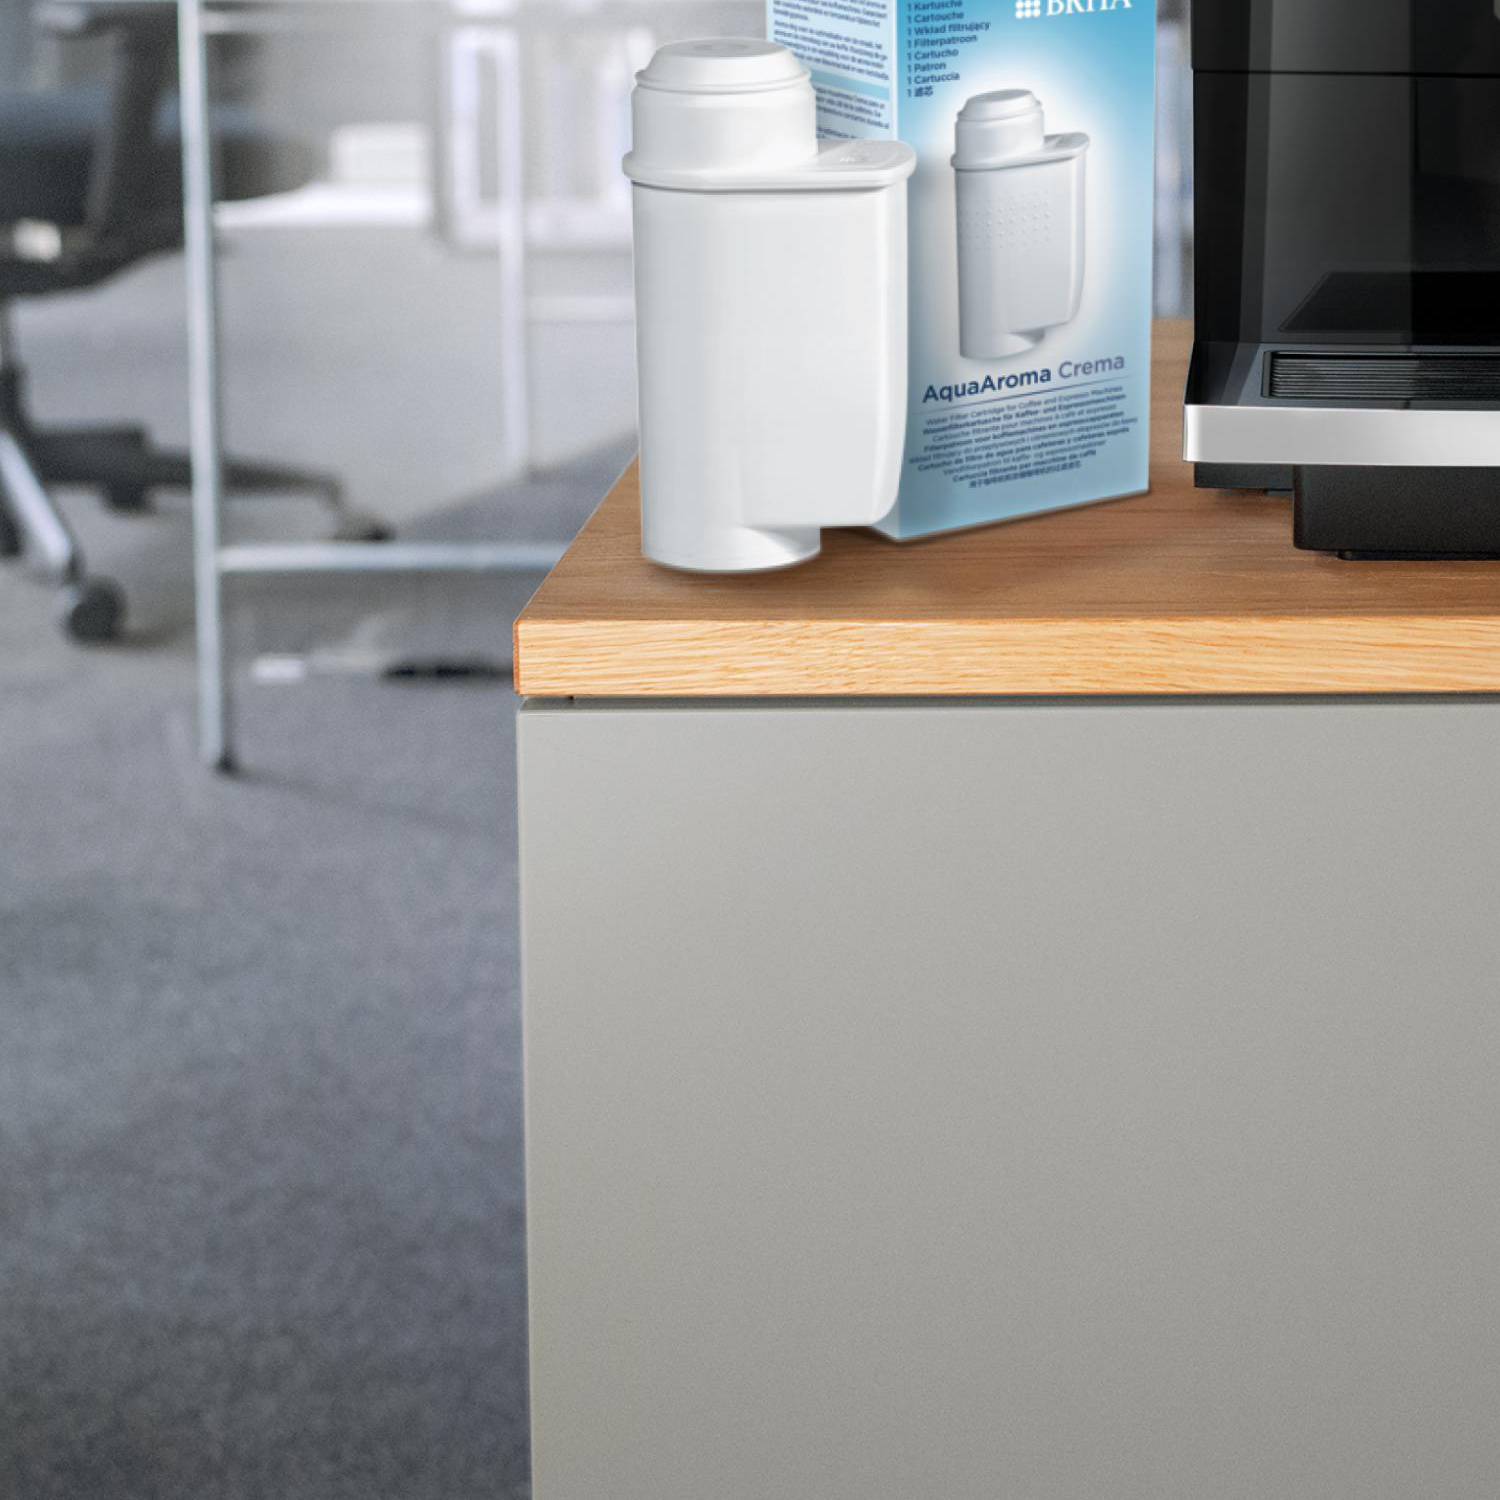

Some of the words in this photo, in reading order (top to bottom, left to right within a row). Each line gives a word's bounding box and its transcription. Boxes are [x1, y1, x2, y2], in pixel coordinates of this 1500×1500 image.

[914, 0, 963, 11] Kartusche
[914, 11, 964, 23] Cartouche
[914, 34, 978, 48] Filterpatroon
[914, 48, 959, 61] Cartucho
[914, 61, 946, 73] Patron
[914, 72, 960, 85] Cartuccia
[922, 368, 1052, 403] AquaAroma
[1058, 355, 1126, 380] Crema
[971, 405, 1004, 418] Cartridge
